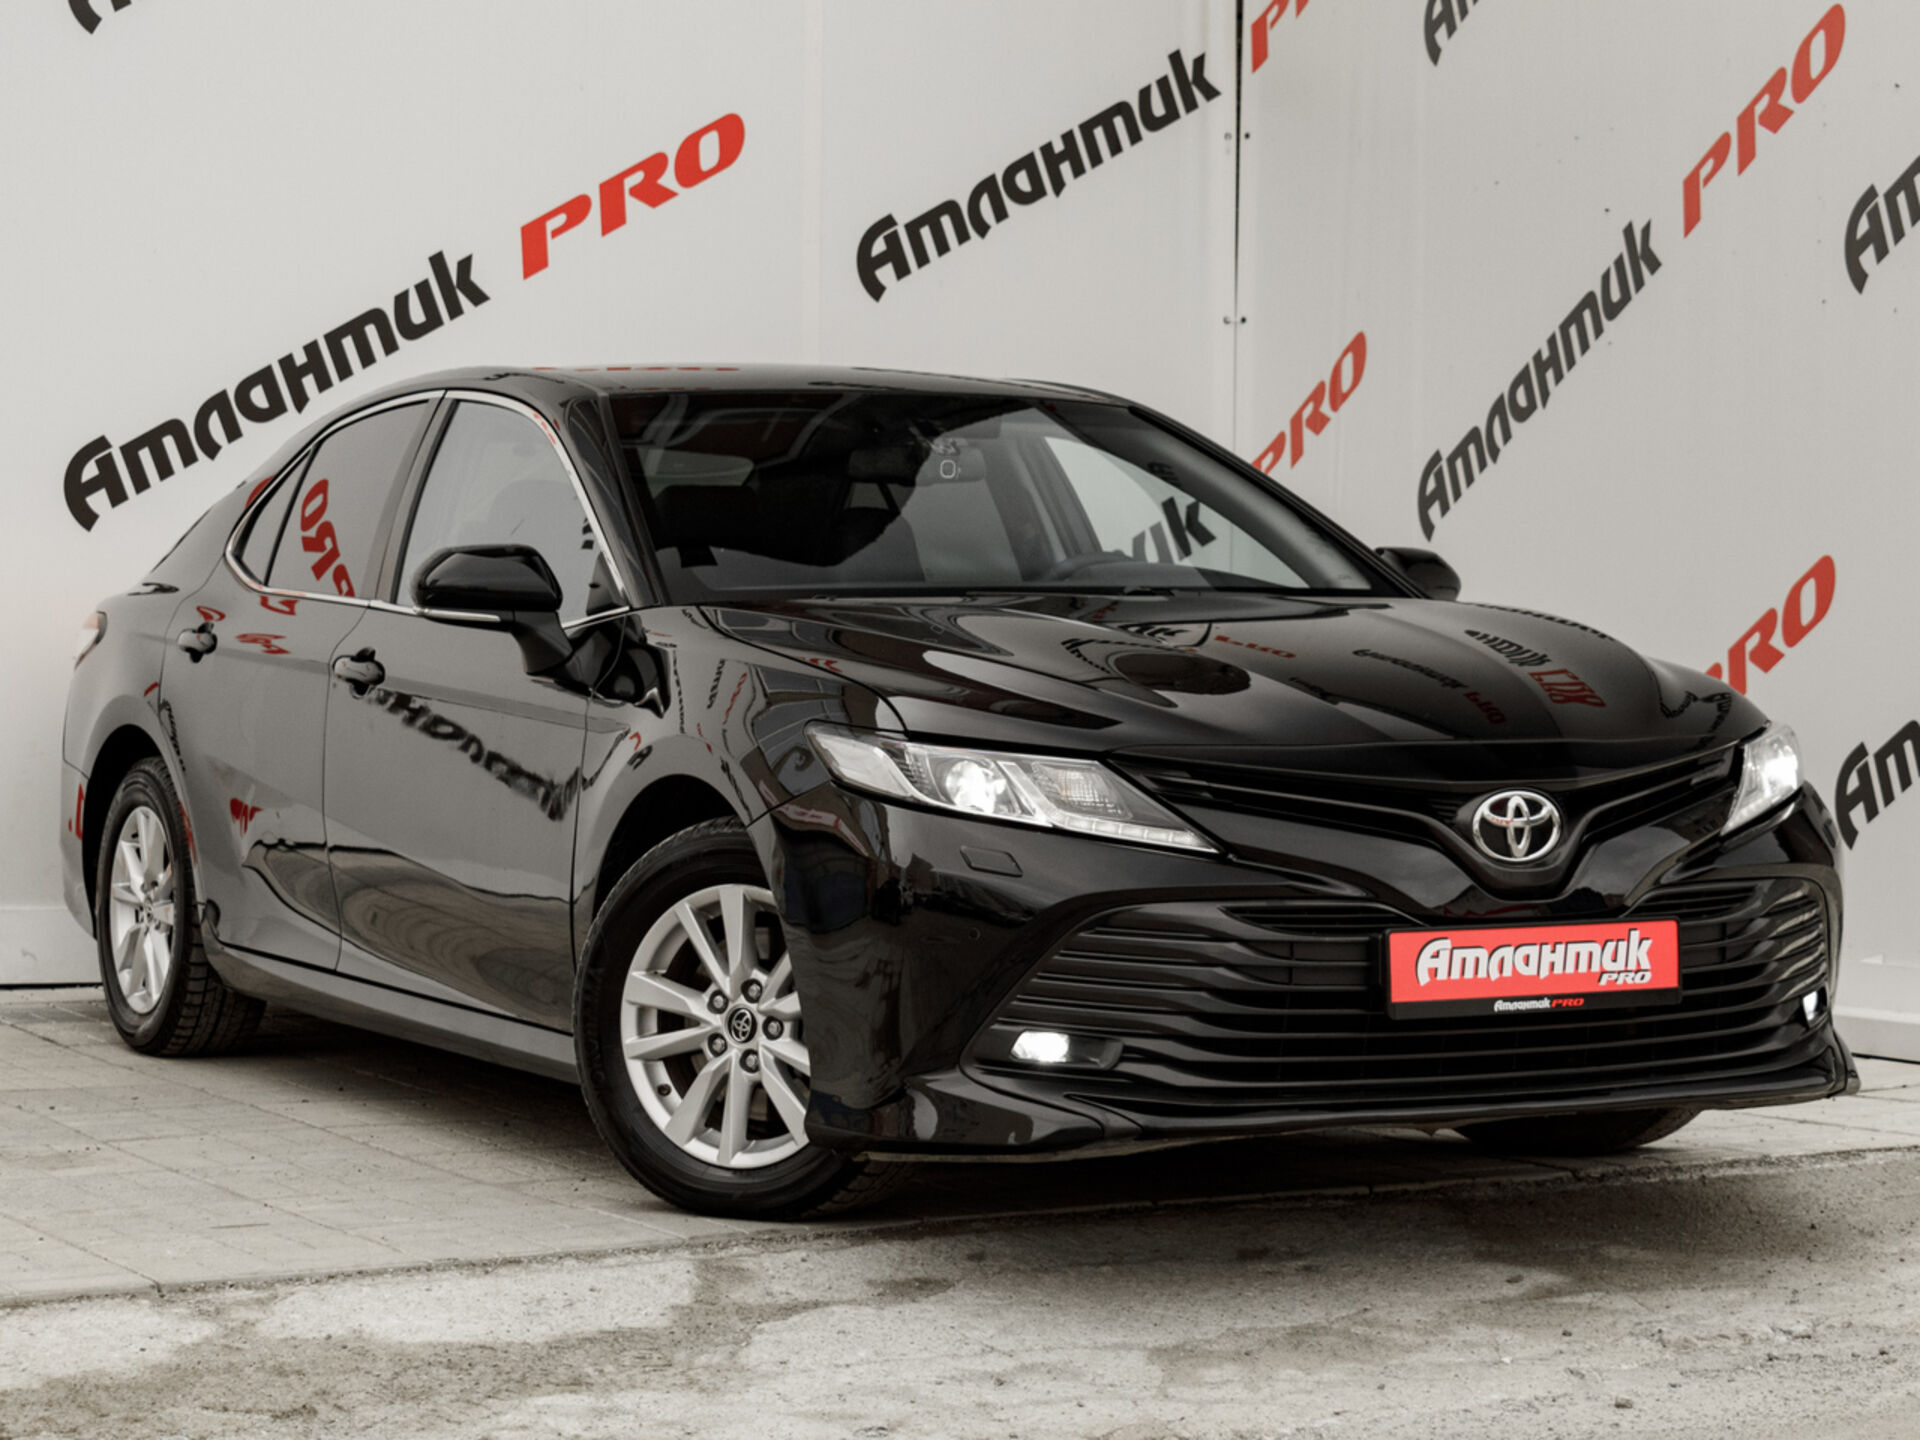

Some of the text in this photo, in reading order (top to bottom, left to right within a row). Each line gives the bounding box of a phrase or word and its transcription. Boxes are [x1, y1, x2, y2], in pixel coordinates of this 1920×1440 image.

[856, 49, 1221, 303] Атлантик
[63, 113, 745, 532] Атлантик PRO
[1417, 219, 1662, 542] Атлантик
[1683, 4, 1845, 238] PRO
[1706, 555, 1835, 695] RO
[1416, 929, 1653, 987] Атлантик
[1551, 998, 1585, 1007] PRO
[1598, 970, 1653, 987] PRO
